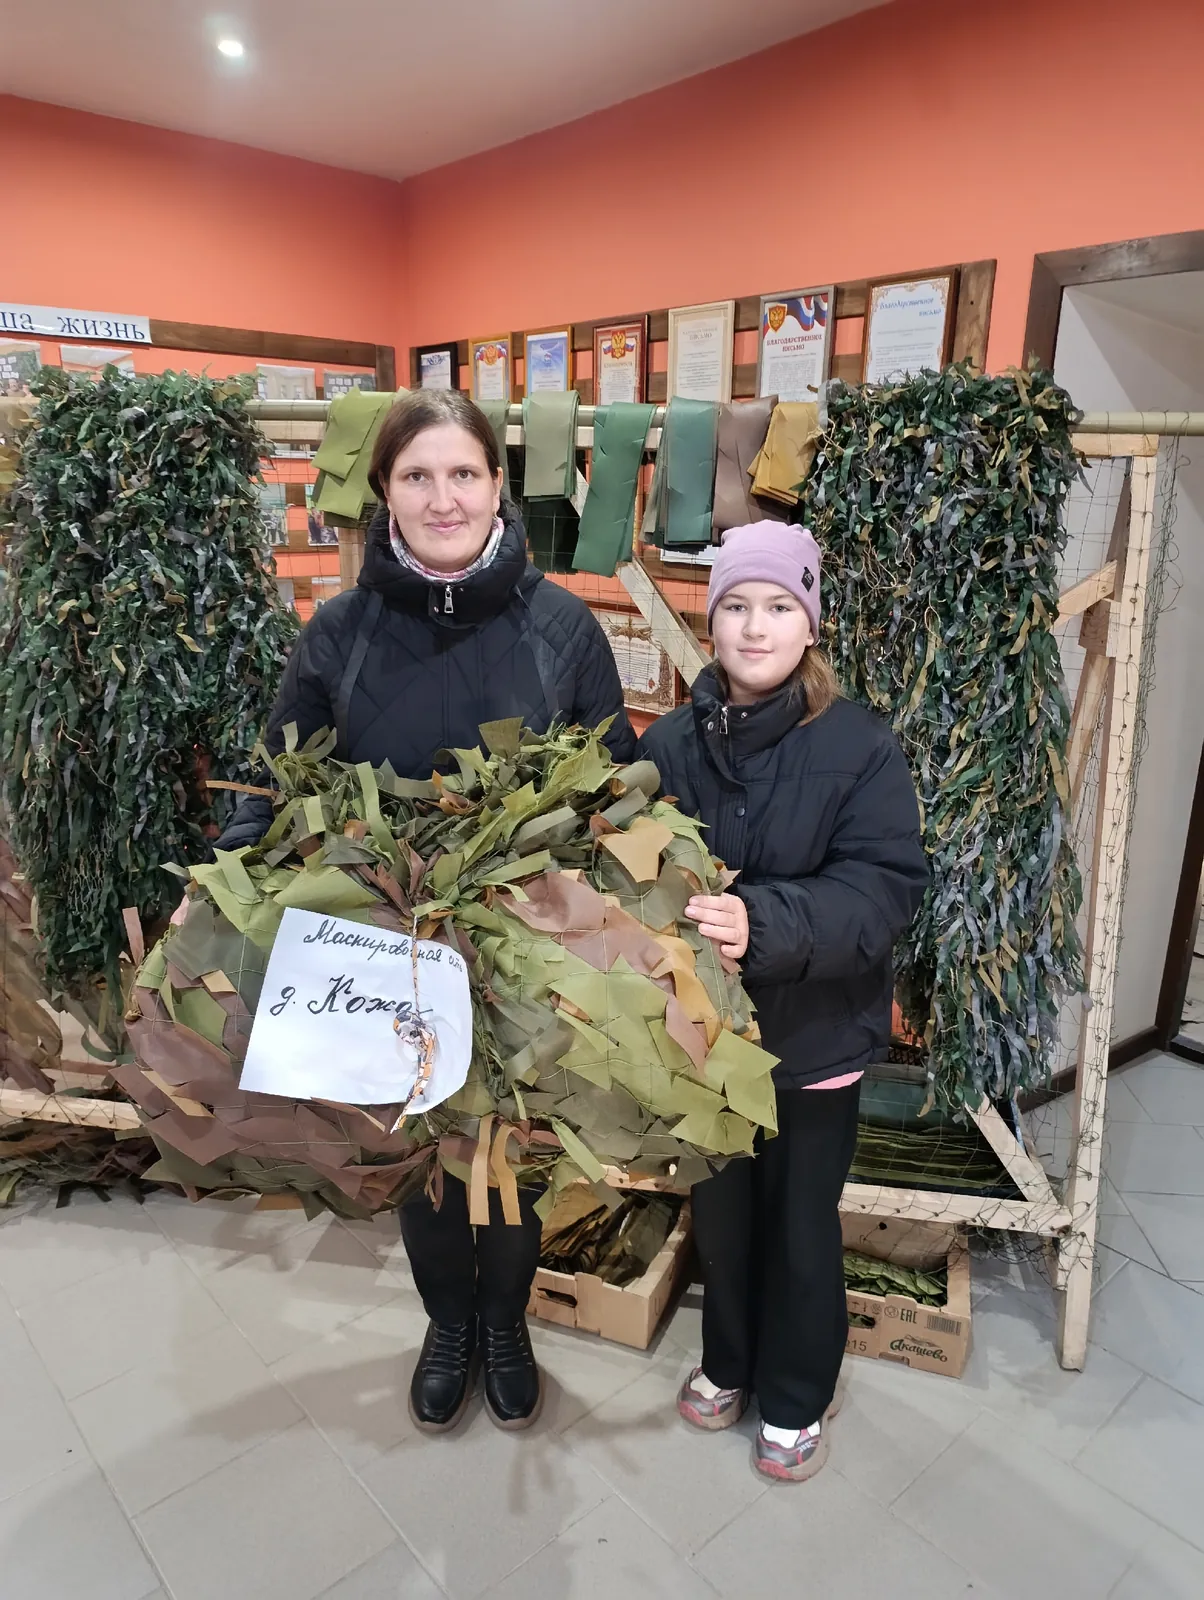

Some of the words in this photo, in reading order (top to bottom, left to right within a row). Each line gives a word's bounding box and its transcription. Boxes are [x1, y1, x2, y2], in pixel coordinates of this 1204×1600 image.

[57, 316, 145, 340] жизнь
[766, 334, 823, 346] БЛАГОДАРСТВЕННОЕ
[782, 344, 805, 352] ПИСЬМО
[269, 986, 296, 1016] д.
[890, 1338, 948, 1363] Акашево
